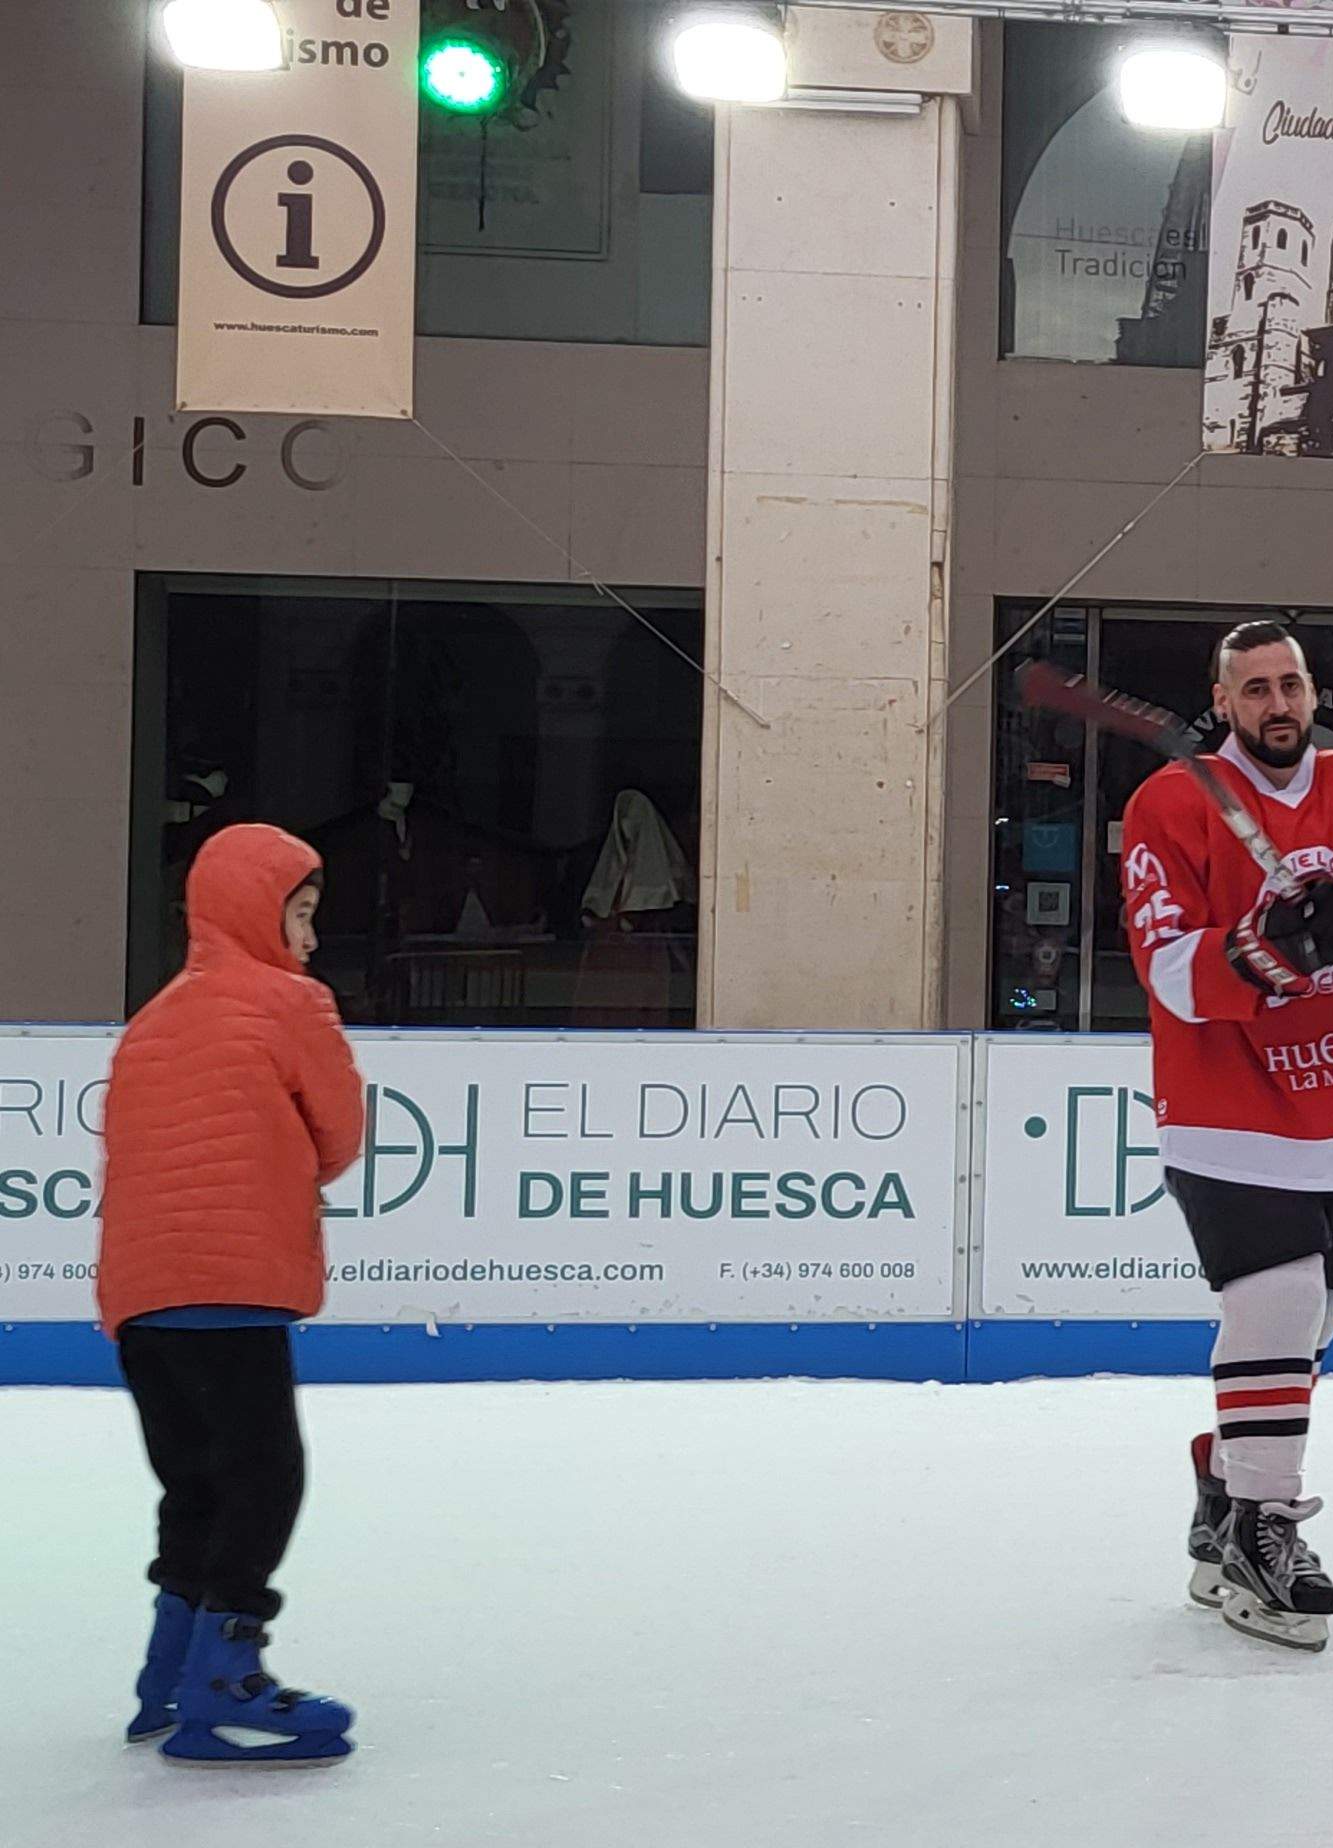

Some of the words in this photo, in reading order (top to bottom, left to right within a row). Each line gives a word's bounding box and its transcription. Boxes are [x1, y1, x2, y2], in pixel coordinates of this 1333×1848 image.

[286, 28, 390, 69] ismo
[213, 321, 379, 338] www.huescaturismo.com
[522, 1082, 614, 1139] EL
[638, 1083, 907, 1142] DIARIO
[518, 1171, 610, 1219] DE
[628, 1172, 915, 1219] HUESCA
[18, 1263, 55, 1280] 974
[719, 1263, 735, 1279] F.
[742, 1261, 792, 1282] (+34)
[798, 1262, 833, 1279] 974
[840, 1262, 874, 1279] 600
[880, 1262, 915, 1279] 008
